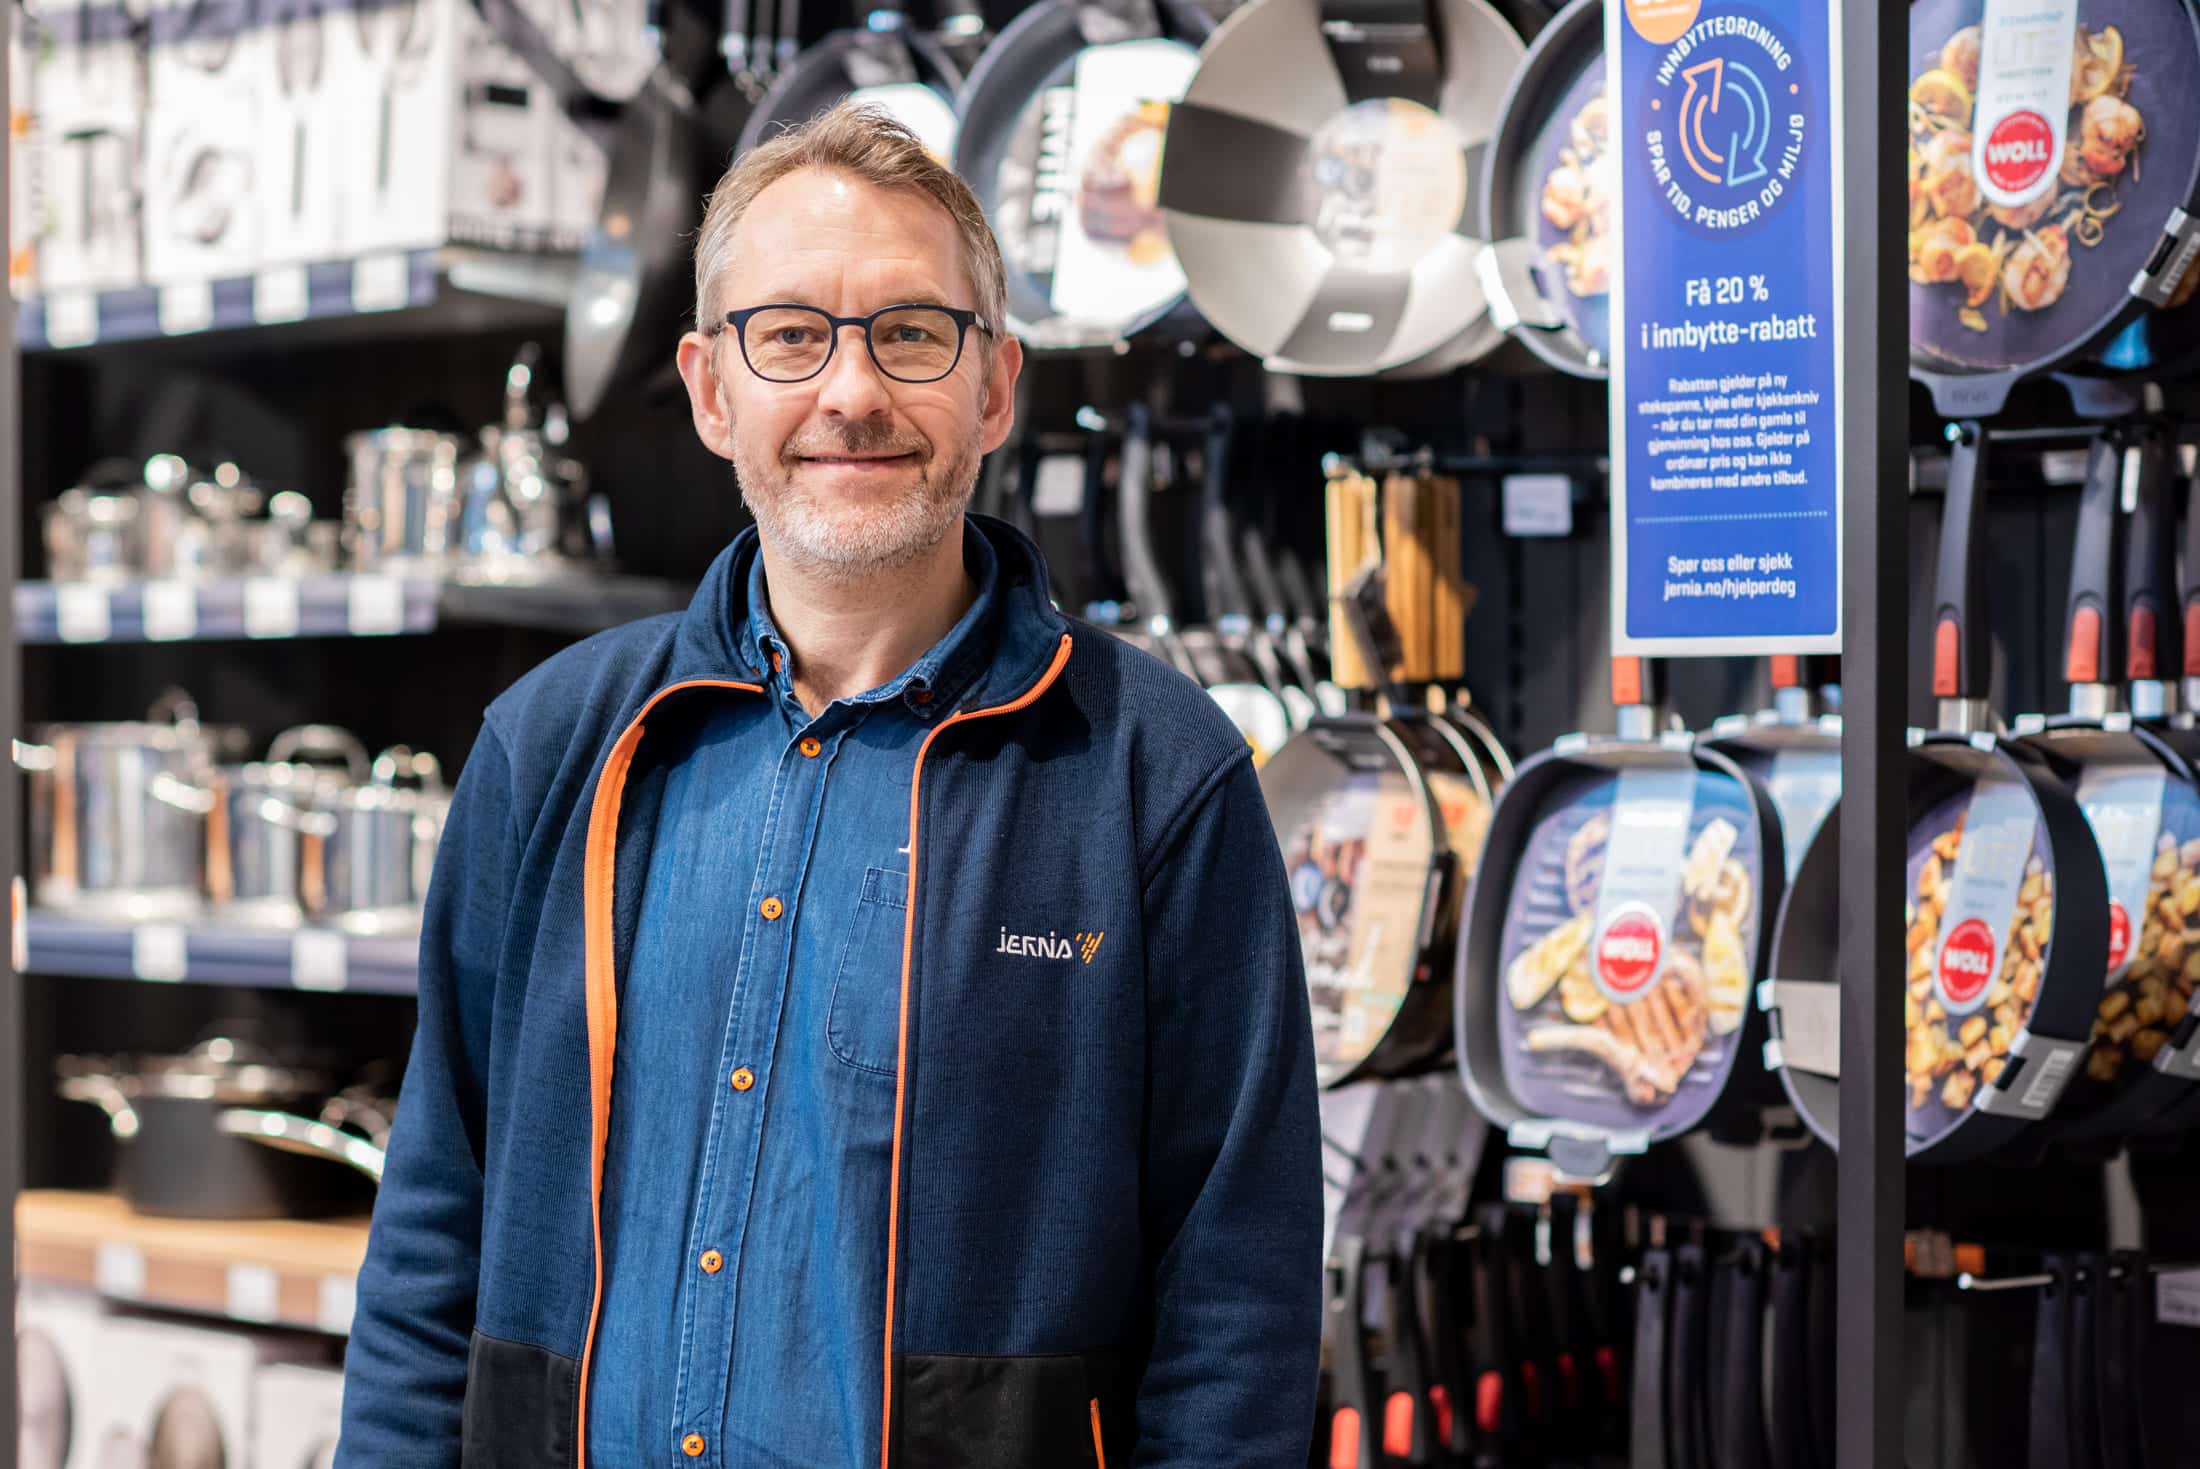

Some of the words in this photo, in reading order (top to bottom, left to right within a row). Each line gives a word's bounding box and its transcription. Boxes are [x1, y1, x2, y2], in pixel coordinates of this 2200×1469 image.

[1656, 16, 1791, 86] INNBYTTEORDNING
[1988, 139, 2048, 165] WOLL
[1646, 130, 1671, 186] SPAR
[1695, 199, 1761, 229] PENGER
[1760, 178, 1783, 208] OG
[1777, 114, 1805, 179] MILJØ
[1686, 278, 1711, 306] Få
[1716, 276, 1743, 305] 20
[1749, 275, 1769, 301] %
[1641, 323, 1648, 349] i
[1652, 314, 1816, 352] innbytte-rabatt
[1669, 376, 1717, 393] Rabatten
[1719, 374, 1757, 393] gjelder
[1758, 372, 1772, 390] på
[1774, 375, 1787, 390] ny
[1704, 397, 1729, 413] kjele
[1731, 394, 1754, 409] eller
[1661, 418, 1679, 432] når
[1681, 417, 1695, 431] du
[1697, 417, 1713, 430] tar
[1715, 414, 1738, 430] med
[1740, 413, 1757, 428] din
[1759, 412, 1793, 429] gamle
[1795, 411, 1806, 425] til
[1711, 434, 1731, 449] hos
[1756, 432, 1793, 449] Gjelder
[1795, 430, 1810, 447] på
[1710, 454, 1730, 471] pris
[1732, 456, 1746, 471] og
[1748, 453, 1768, 466] kan
[1770, 451, 1792, 465] ikke
[1651, 475, 1713, 491] kombineres
[1715, 473, 1739, 488] med
[1740, 472, 1771, 487] andre
[1668, 555, 1699, 576] Spør
[1701, 557, 1724, 573] oss
[1727, 553, 1756, 571] eller
[1758, 552, 1792, 575] sjekk
[1663, 577, 1796, 601] jernia.no/hjelperdeg
[1944, 947, 1989, 976] WOLL
